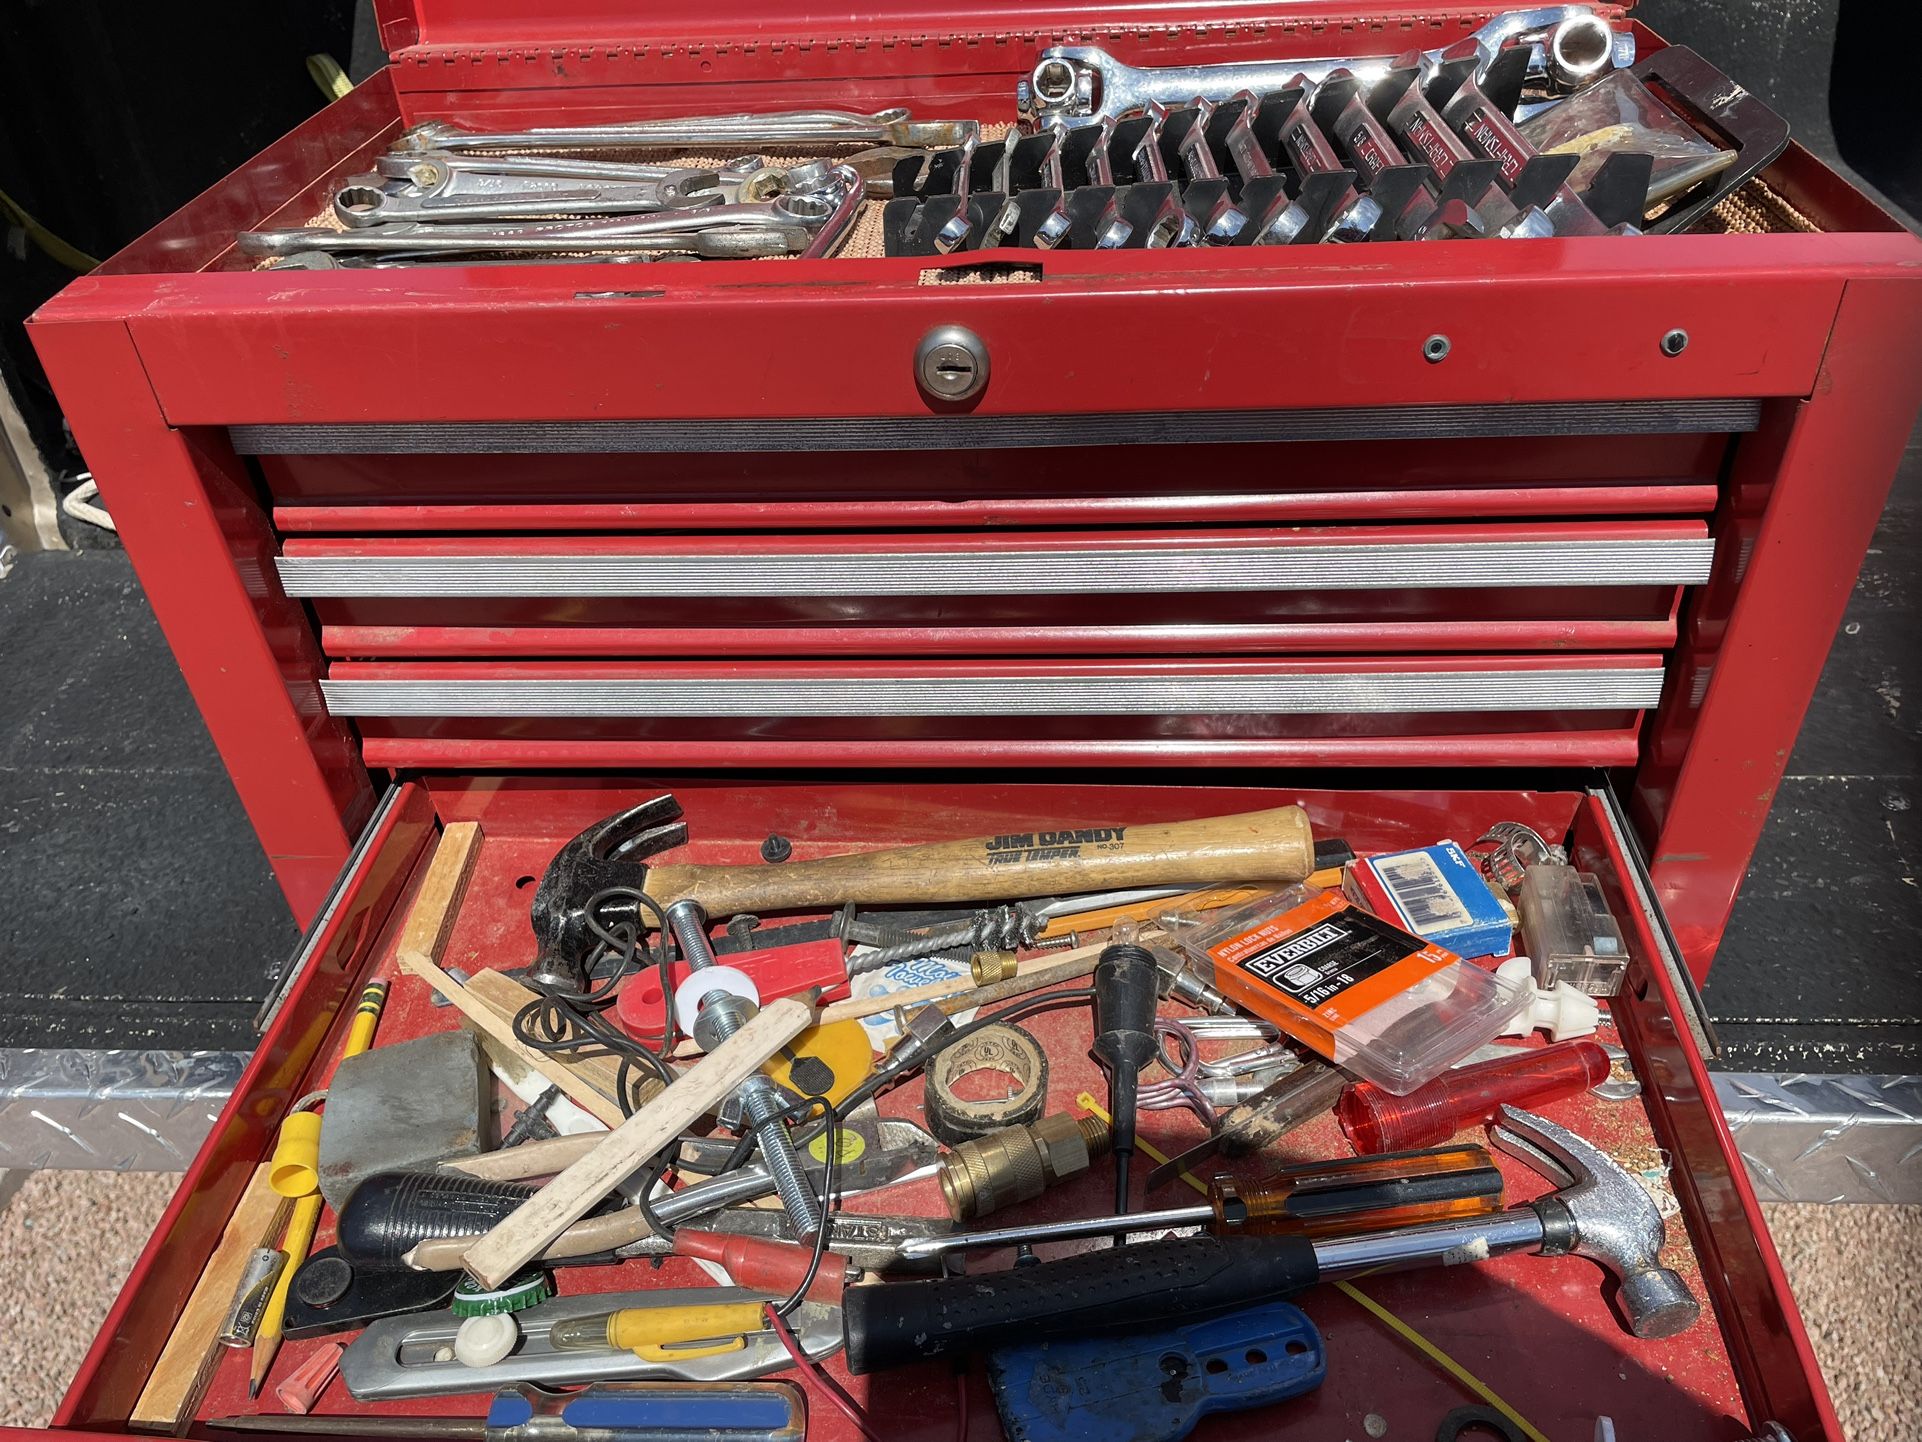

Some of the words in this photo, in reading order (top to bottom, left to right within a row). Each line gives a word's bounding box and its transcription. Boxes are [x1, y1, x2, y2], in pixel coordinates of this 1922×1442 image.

[986, 832, 1034, 850] JIM
[1038, 827, 1127, 846] DANDY
[987, 850, 1022, 865] TRUE
[1445, 847, 1466, 869] SKF
[1217, 942, 1244, 958] NYLON
[1241, 933, 1262, 946] LOCK
[1257, 925, 1280, 938] NUTS
[1254, 926, 1339, 973] EVERBILT
[1416, 950, 1443, 964] 15
[1303, 986, 1330, 1004] 5/16
[1324, 984, 1339, 993] in
[1336, 973, 1355, 985] 18
[824, 1222, 881, 1240] STAN
